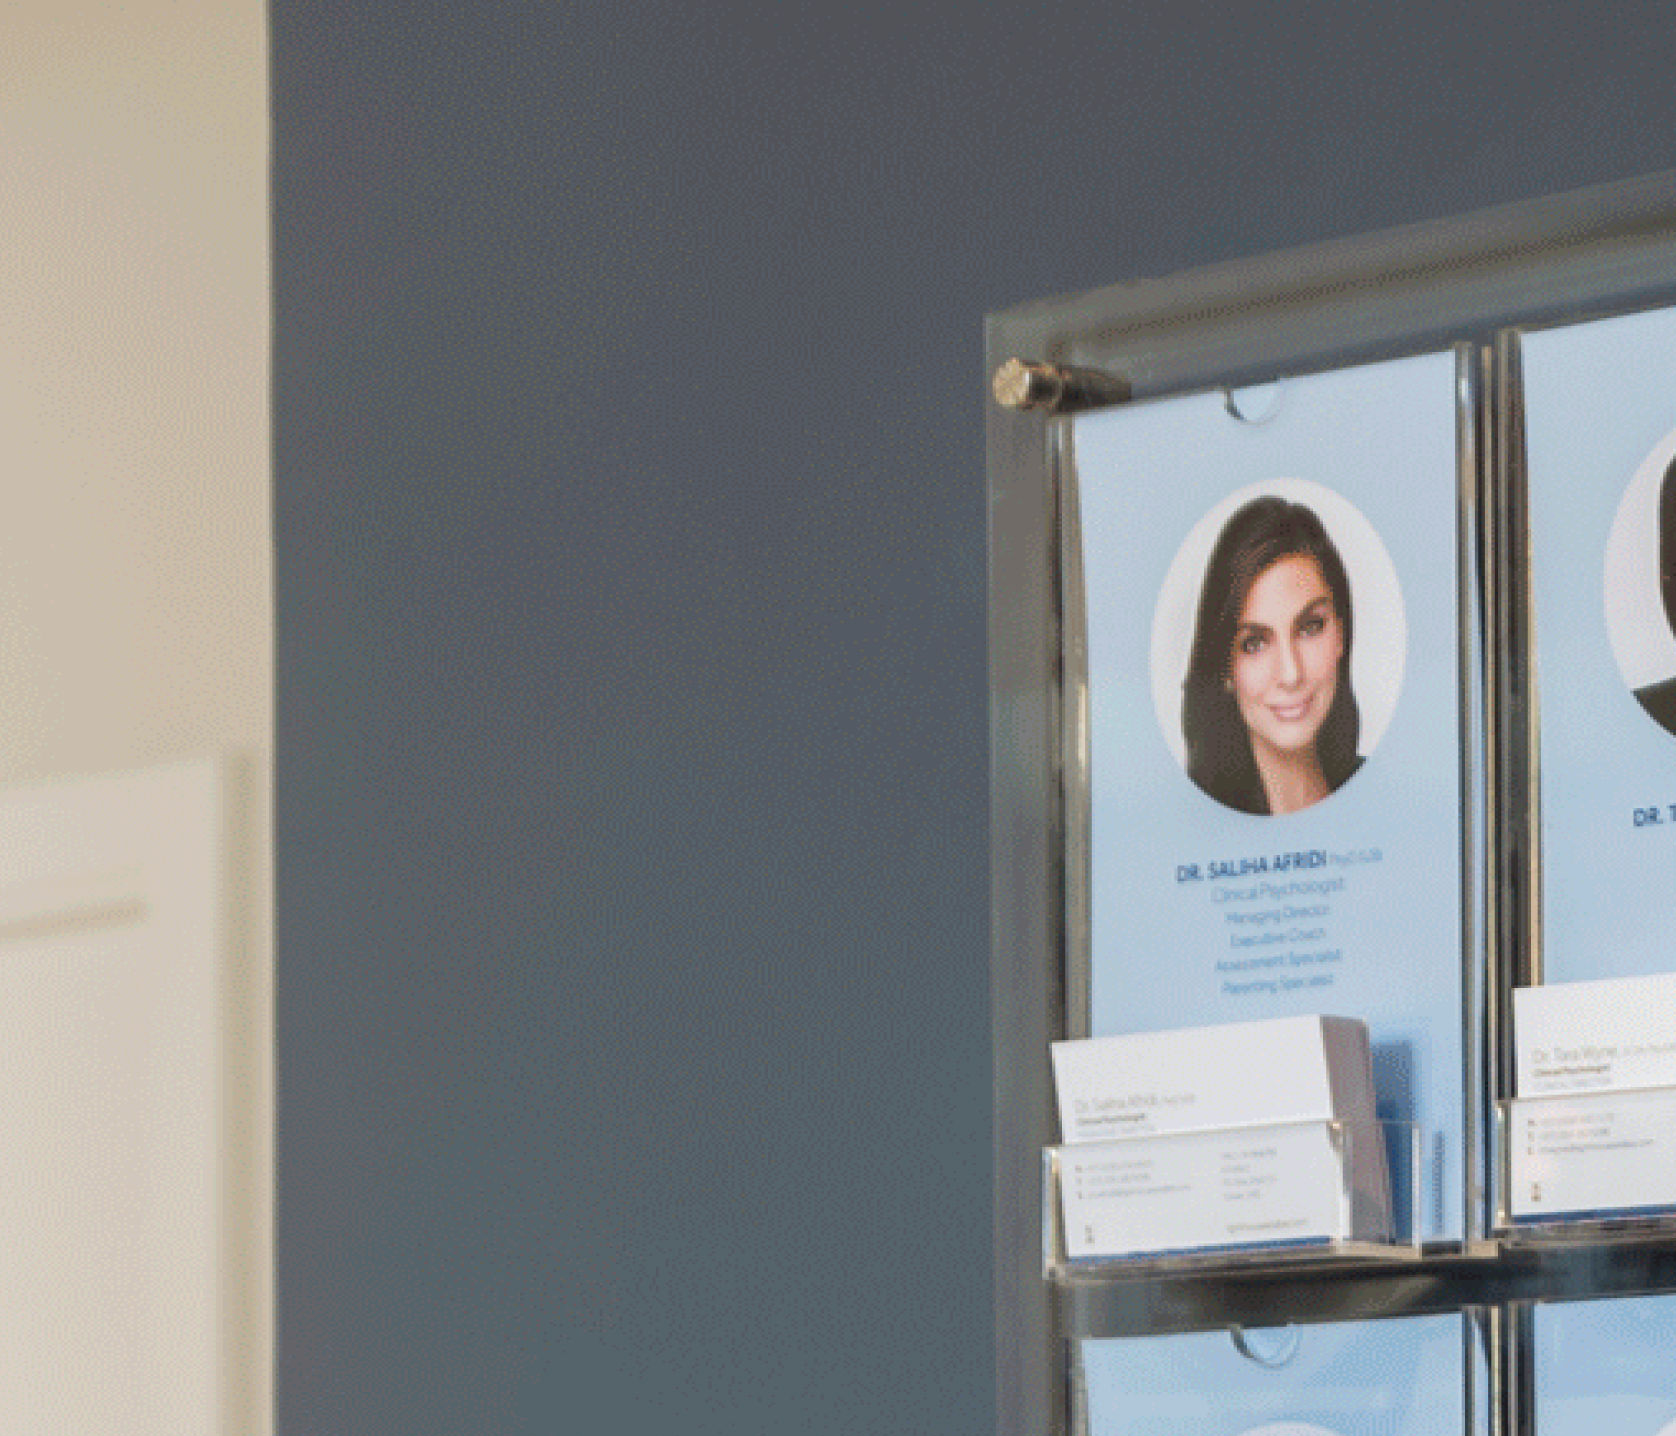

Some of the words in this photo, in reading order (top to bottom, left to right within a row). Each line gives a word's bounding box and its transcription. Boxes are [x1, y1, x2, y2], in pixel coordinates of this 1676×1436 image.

[1633, 806, 1663, 826] DR.
[1176, 865, 1205, 883] DR.
[1207, 856, 1269, 879] SALIHA
[1273, 849, 1328, 871] AFRIDI
